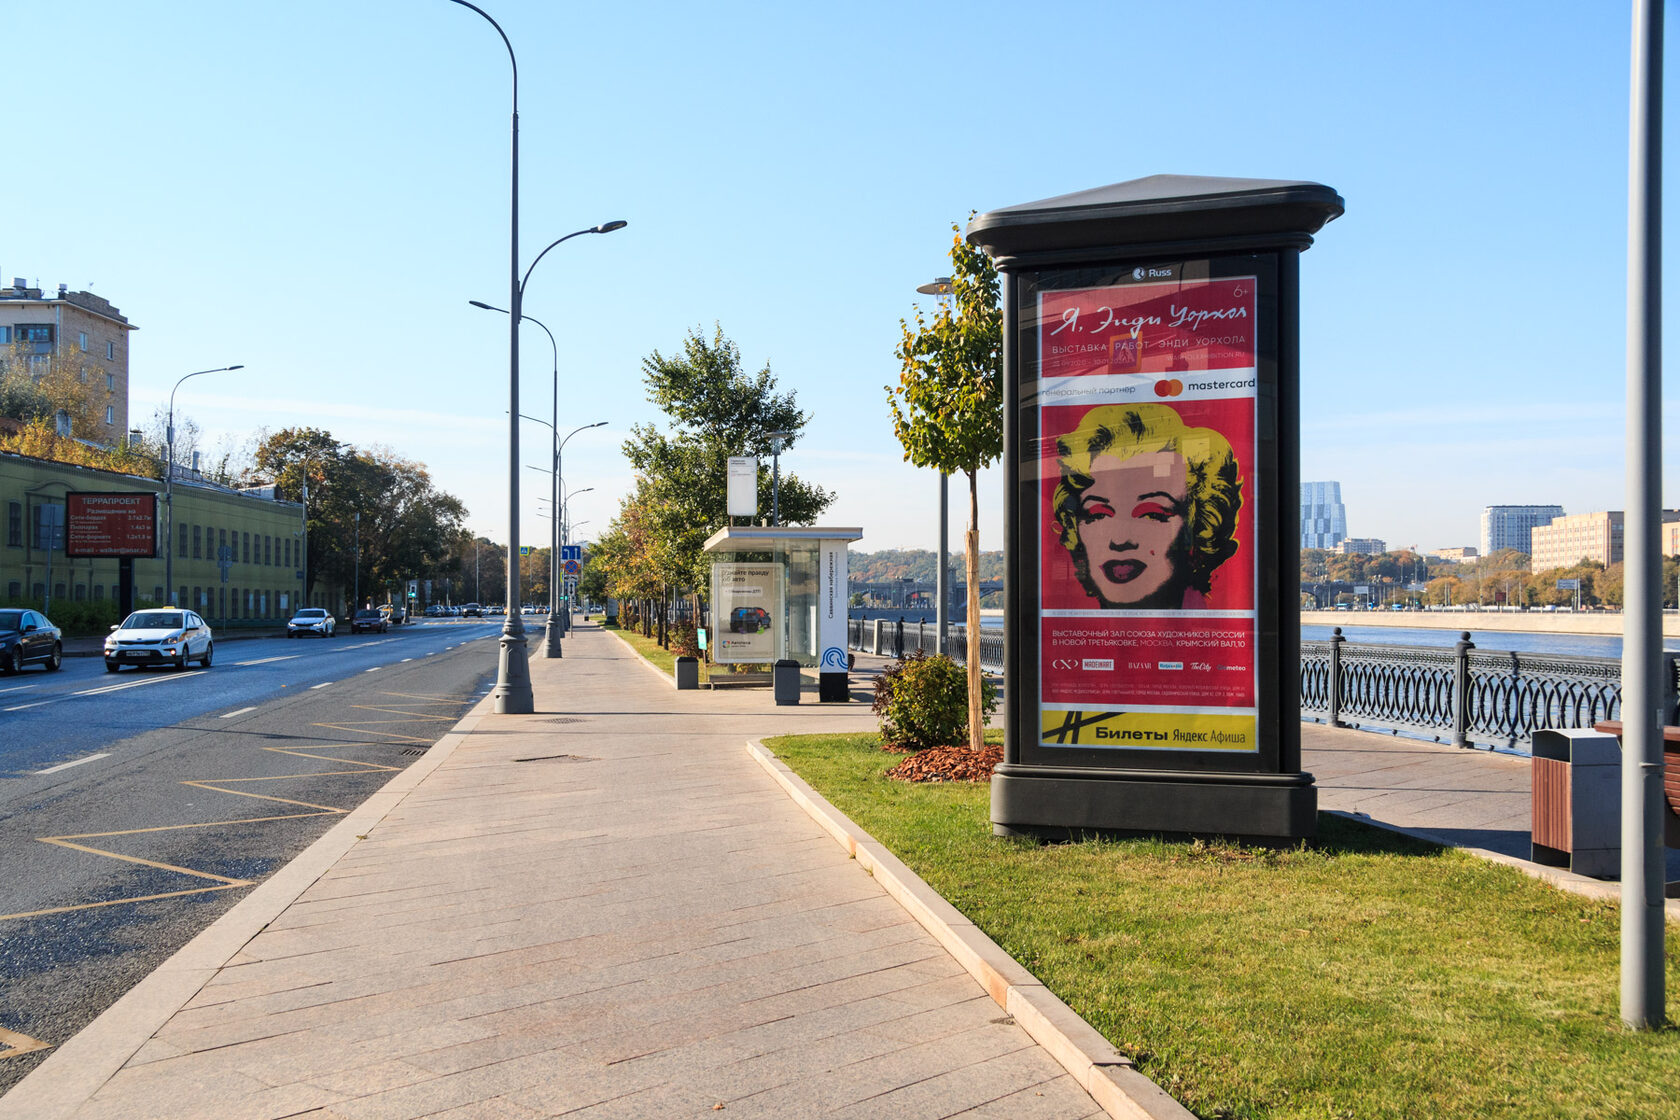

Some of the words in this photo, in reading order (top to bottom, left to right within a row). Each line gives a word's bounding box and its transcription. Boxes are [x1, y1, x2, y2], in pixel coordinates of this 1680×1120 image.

[1148, 269, 1172, 278] Russ
[1233, 285, 1249, 298] 6+
[1050, 307, 1083, 336] Я,
[1090, 306, 1161, 339] Энди
[1052, 344, 1107, 354] ВЫСТАВКА
[1115, 340, 1150, 351] РАБОТ
[1158, 339, 1189, 349] ЭНДИ
[1196, 336, 1246, 346] УОРХОЛА
[1188, 378, 1255, 391] mastercard
[1042, 386, 1097, 397] генеральный
[1099, 386, 1136, 395] партнер
[1052, 629, 1109, 638] ВЫСТАВОЧНЫЙ
[1157, 631, 1210, 639] ХУДОЖНИКОВ
[1058, 638, 1087, 646] НОВОЙ
[1176, 639, 1219, 648] КРЫМСКИЙ
[1095, 727, 1168, 740] Билеты
[1173, 729, 1208, 742] Яндекс
[1210, 730, 1246, 744] Афиша
